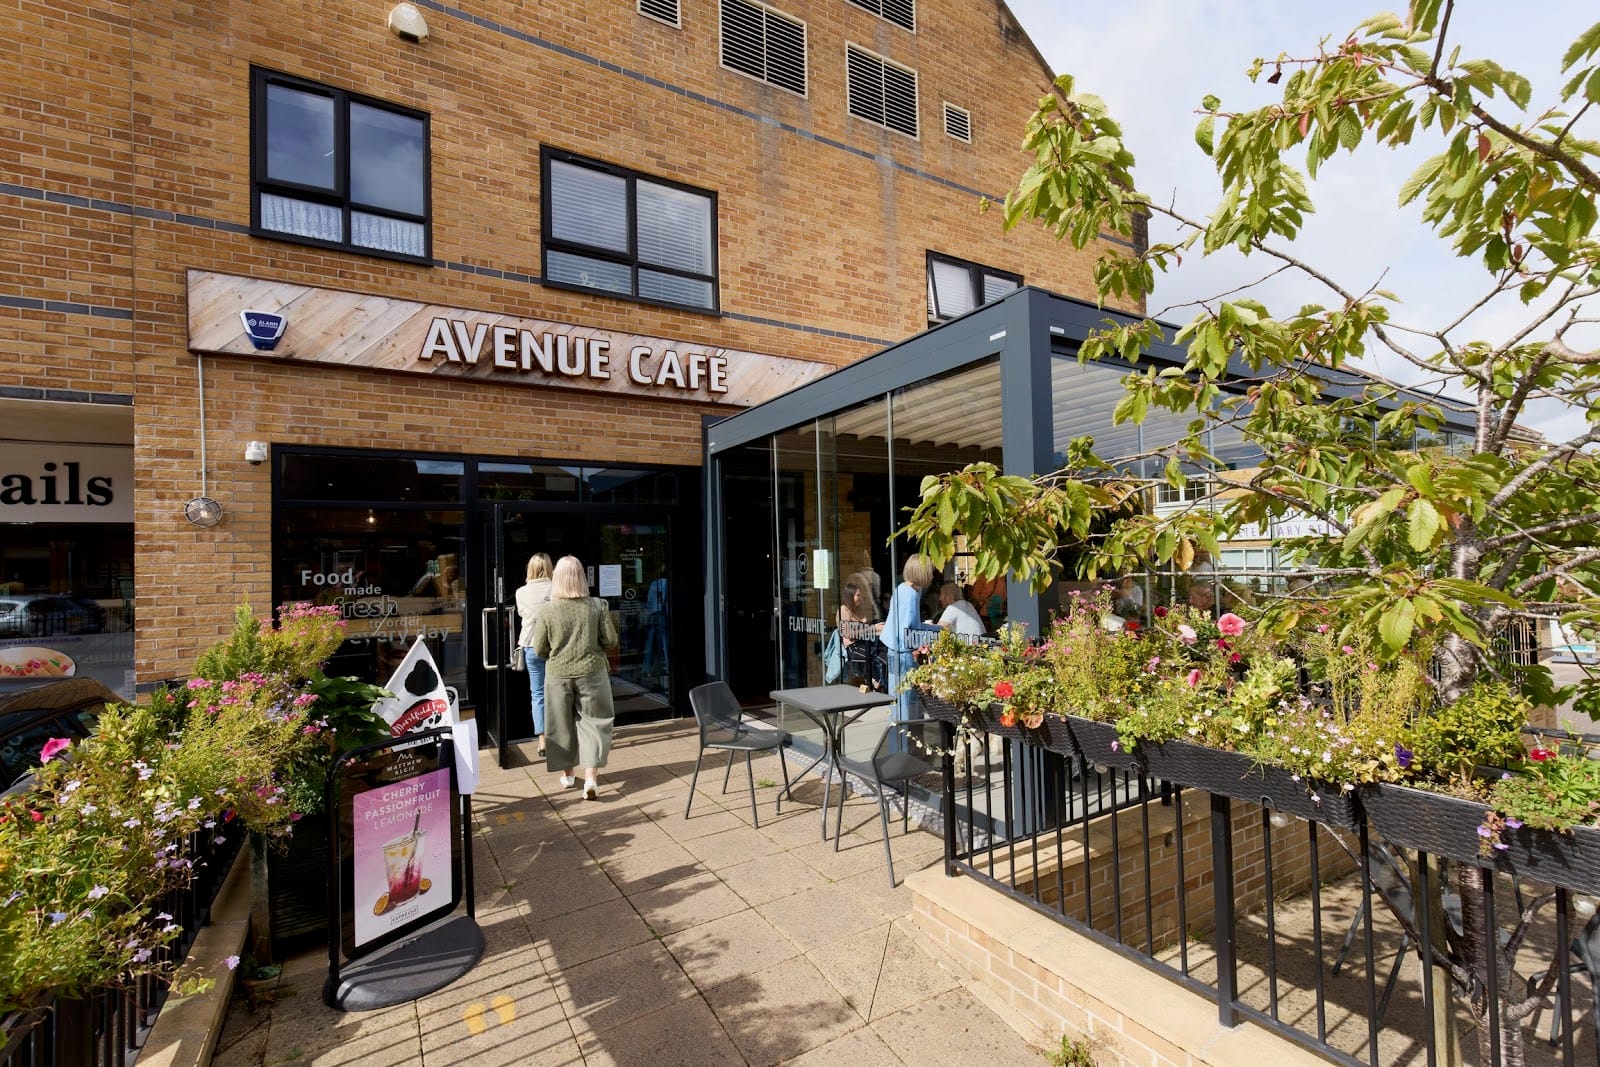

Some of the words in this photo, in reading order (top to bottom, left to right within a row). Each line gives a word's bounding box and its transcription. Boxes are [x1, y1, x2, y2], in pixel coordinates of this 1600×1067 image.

[418, 317, 611, 380] AVENUE
[628, 345, 729, 394] CAFÉ
[0, 462, 114, 506] ails
[301, 568, 353, 586] Food
[344, 584, 382, 596] made
[334, 595, 398, 618] fresh
[369, 616, 381, 628] to
[387, 612, 421, 627] order
[789, 616, 805, 632] FLAT
[805, 618, 827, 635] WHITE
[415, 624, 450, 642] day
[840, 621, 876, 641] CORTADO
[387, 758, 422, 772] MATTHEW
[395, 765, 415, 776] ALGIE
[383, 782, 425, 802] CHERRY
[365, 789, 441, 820] PASSIONFRUIT
[374, 803, 433, 830] LEMONADE
